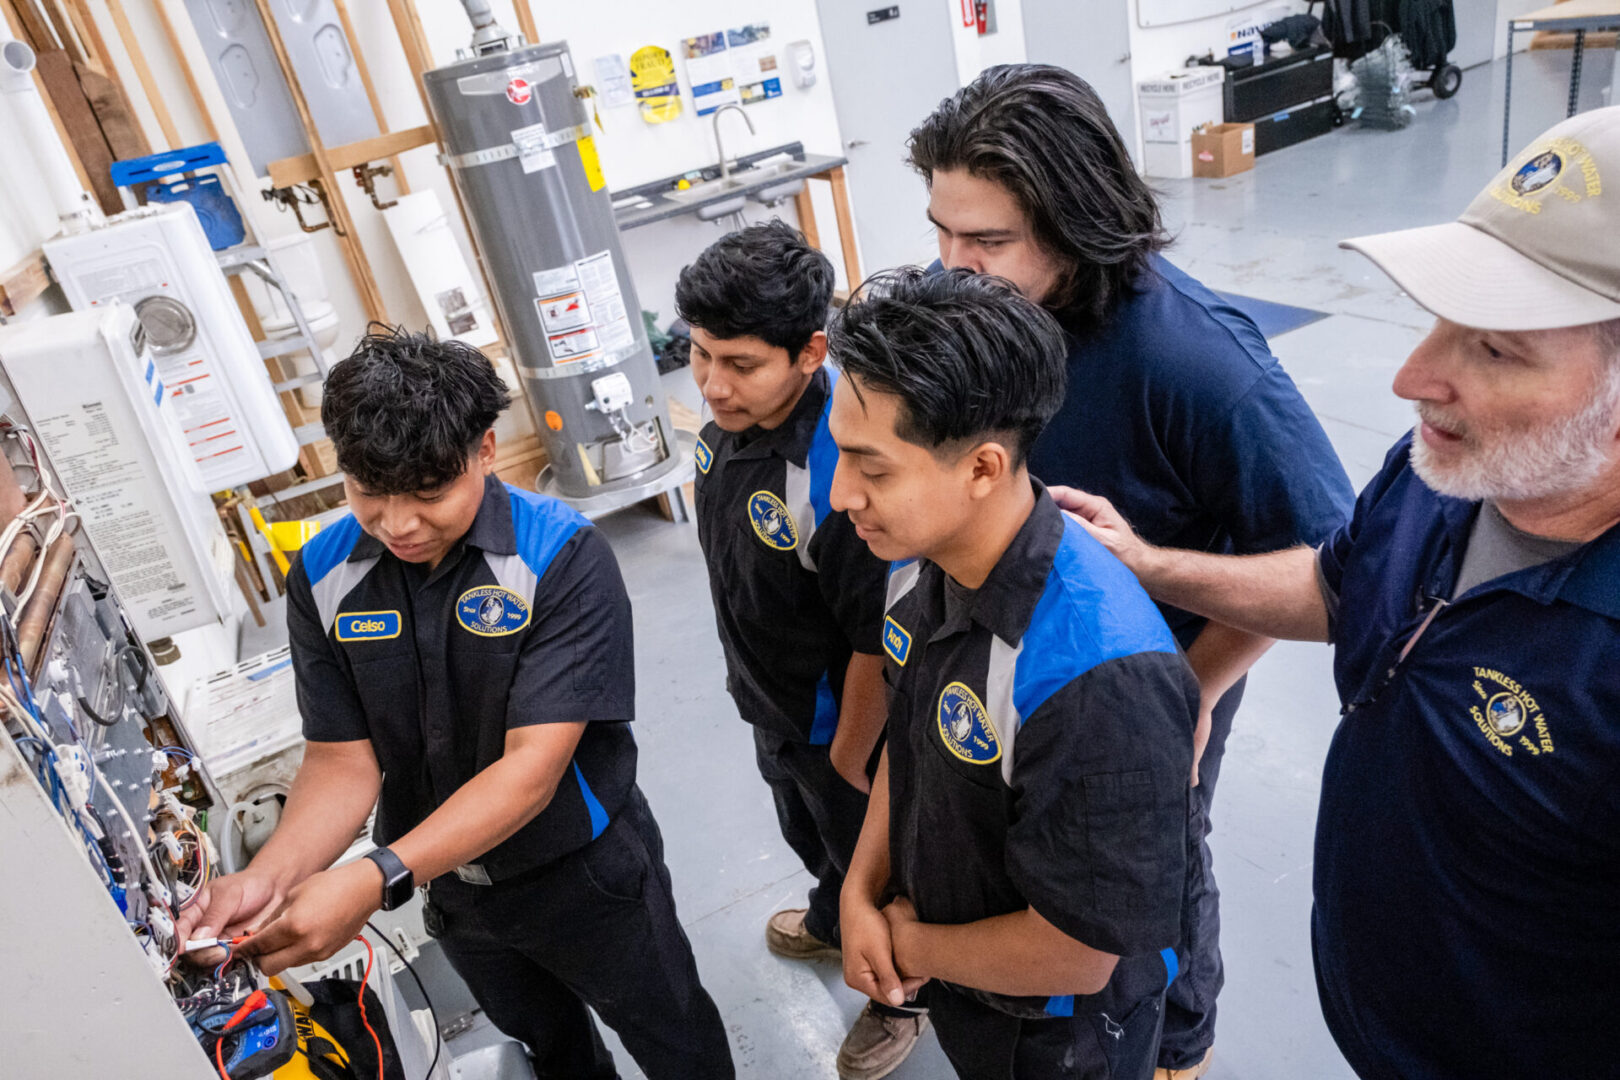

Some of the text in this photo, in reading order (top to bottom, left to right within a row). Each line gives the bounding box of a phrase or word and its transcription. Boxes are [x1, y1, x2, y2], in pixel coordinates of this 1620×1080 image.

[461, 589, 527, 612] TANKLESS HOT WATER
[350, 619, 386, 633] Celso
[470, 621, 508, 633] SOLUTIONS
[887, 627, 903, 653] Andy
[966, 694, 977, 712] HOT
[975, 710, 995, 742] WATER
[1472, 666, 1554, 753] TANKLESS HOT WATER
[942, 724, 973, 757] SOLUTIONS
[1469, 705, 1513, 756] SOLUTIONS
[1519, 735, 1540, 755] 1999
